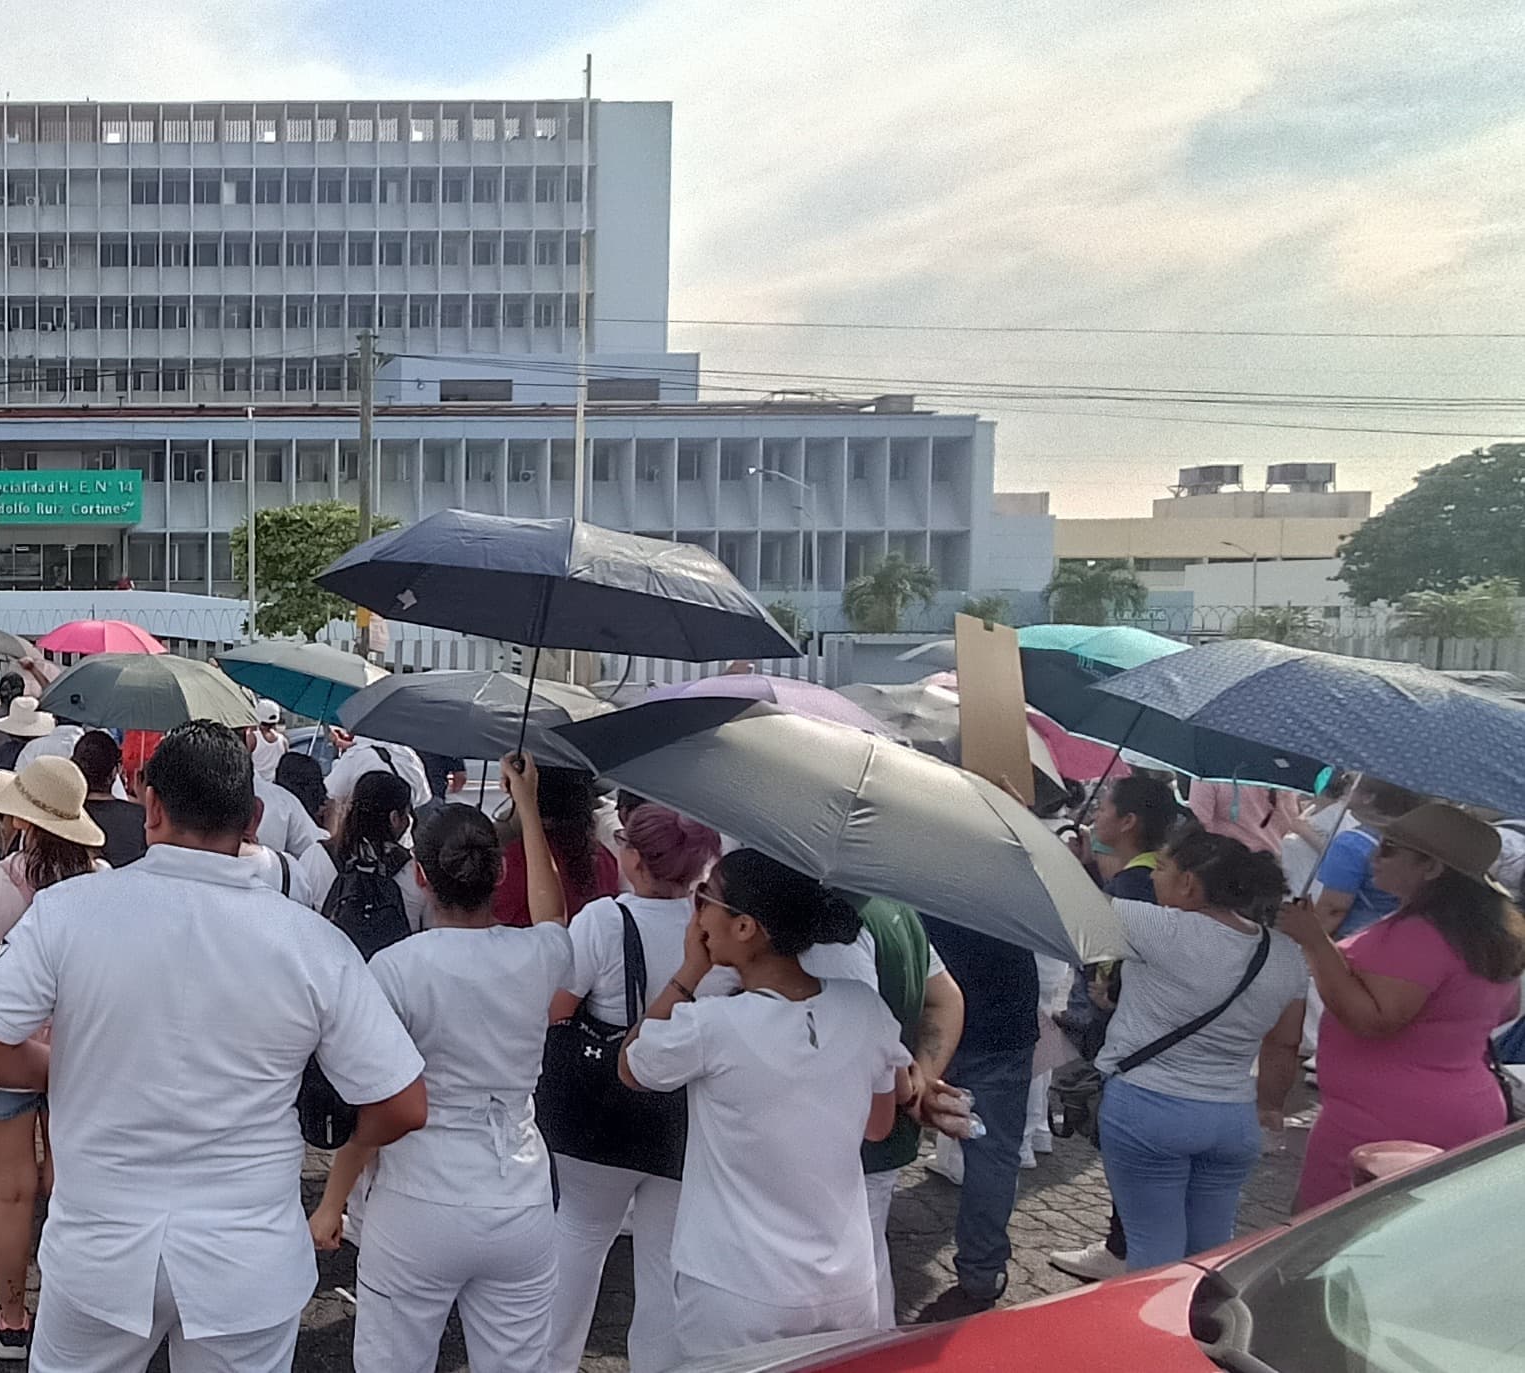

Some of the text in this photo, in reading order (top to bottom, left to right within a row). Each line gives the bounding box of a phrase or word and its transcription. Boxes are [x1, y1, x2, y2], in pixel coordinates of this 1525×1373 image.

[59, 481, 74, 493] H.
[118, 481, 133, 493] 14
[36, 502, 64, 515] Ruiz
